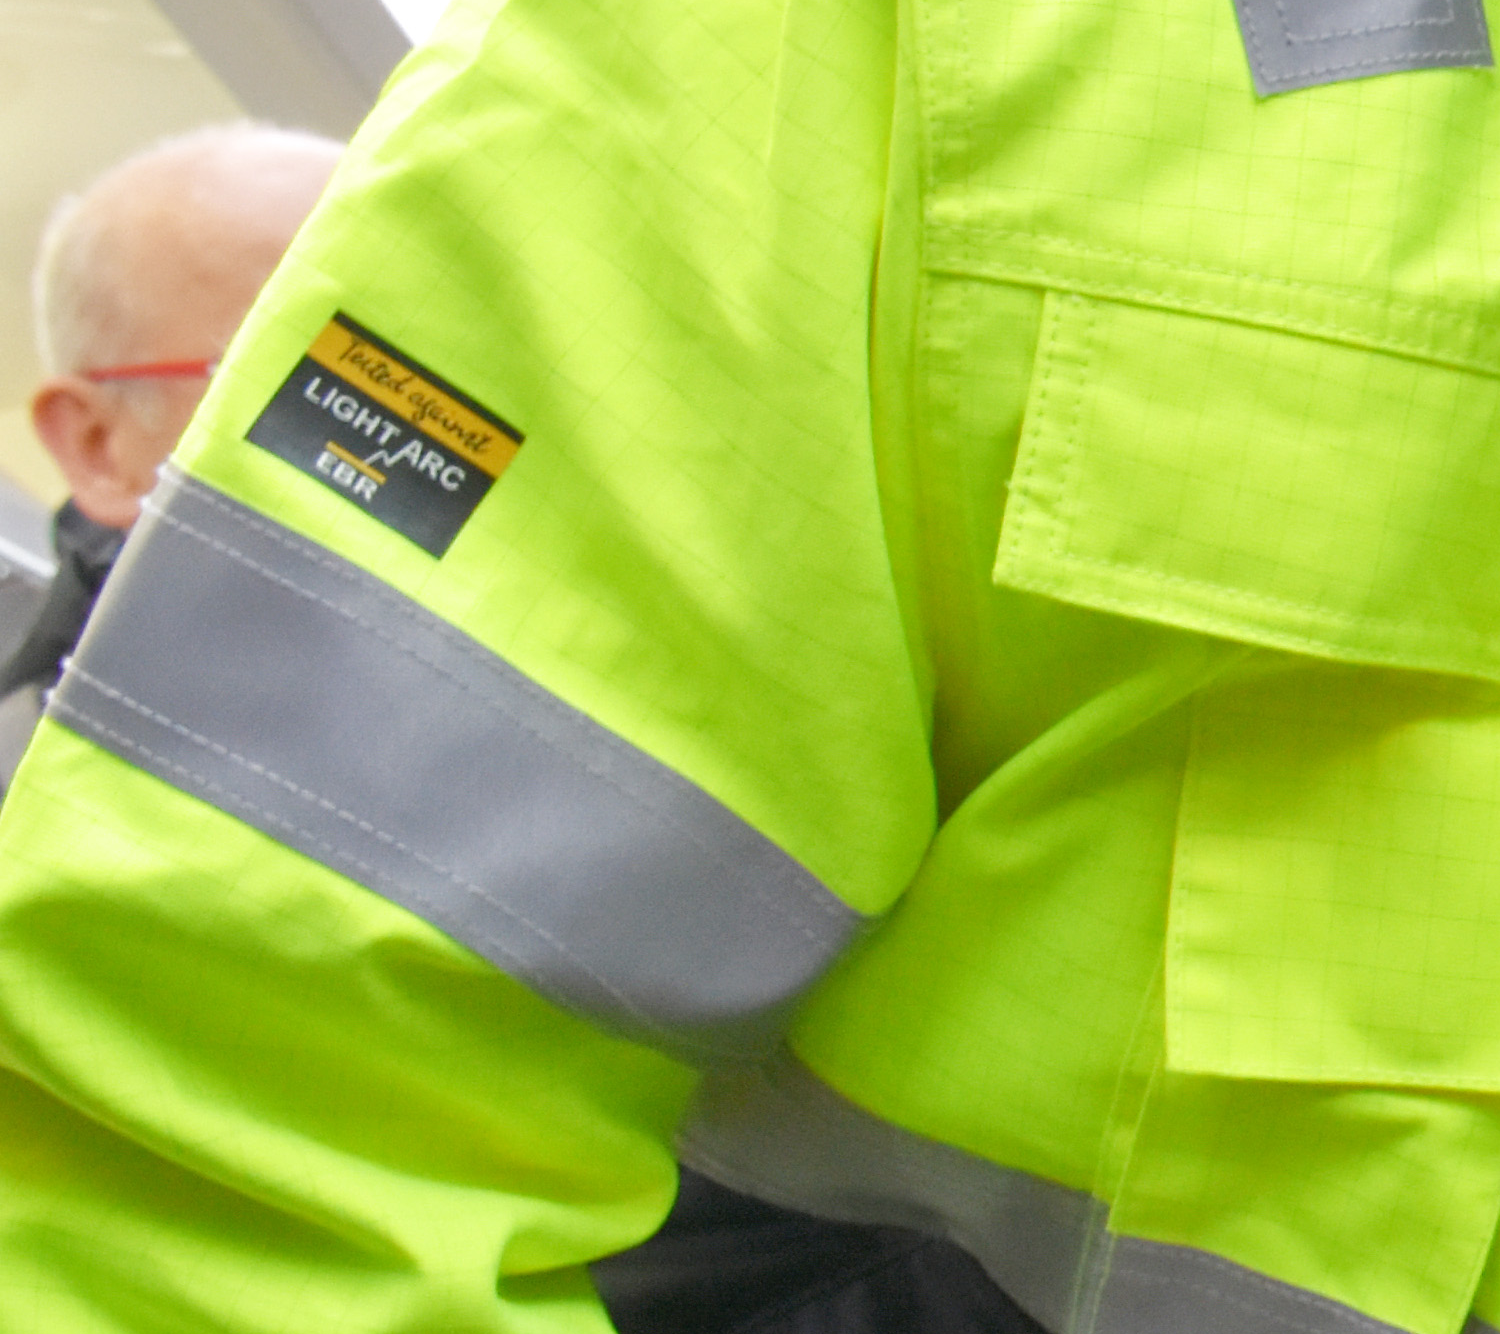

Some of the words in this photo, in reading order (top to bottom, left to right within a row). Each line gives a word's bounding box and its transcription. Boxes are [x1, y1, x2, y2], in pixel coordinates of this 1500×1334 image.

[303, 376, 401, 446] LIGHT
[400, 440, 466, 492] ARC
[409, 390, 494, 455] against
[315, 450, 378, 502] EBR
